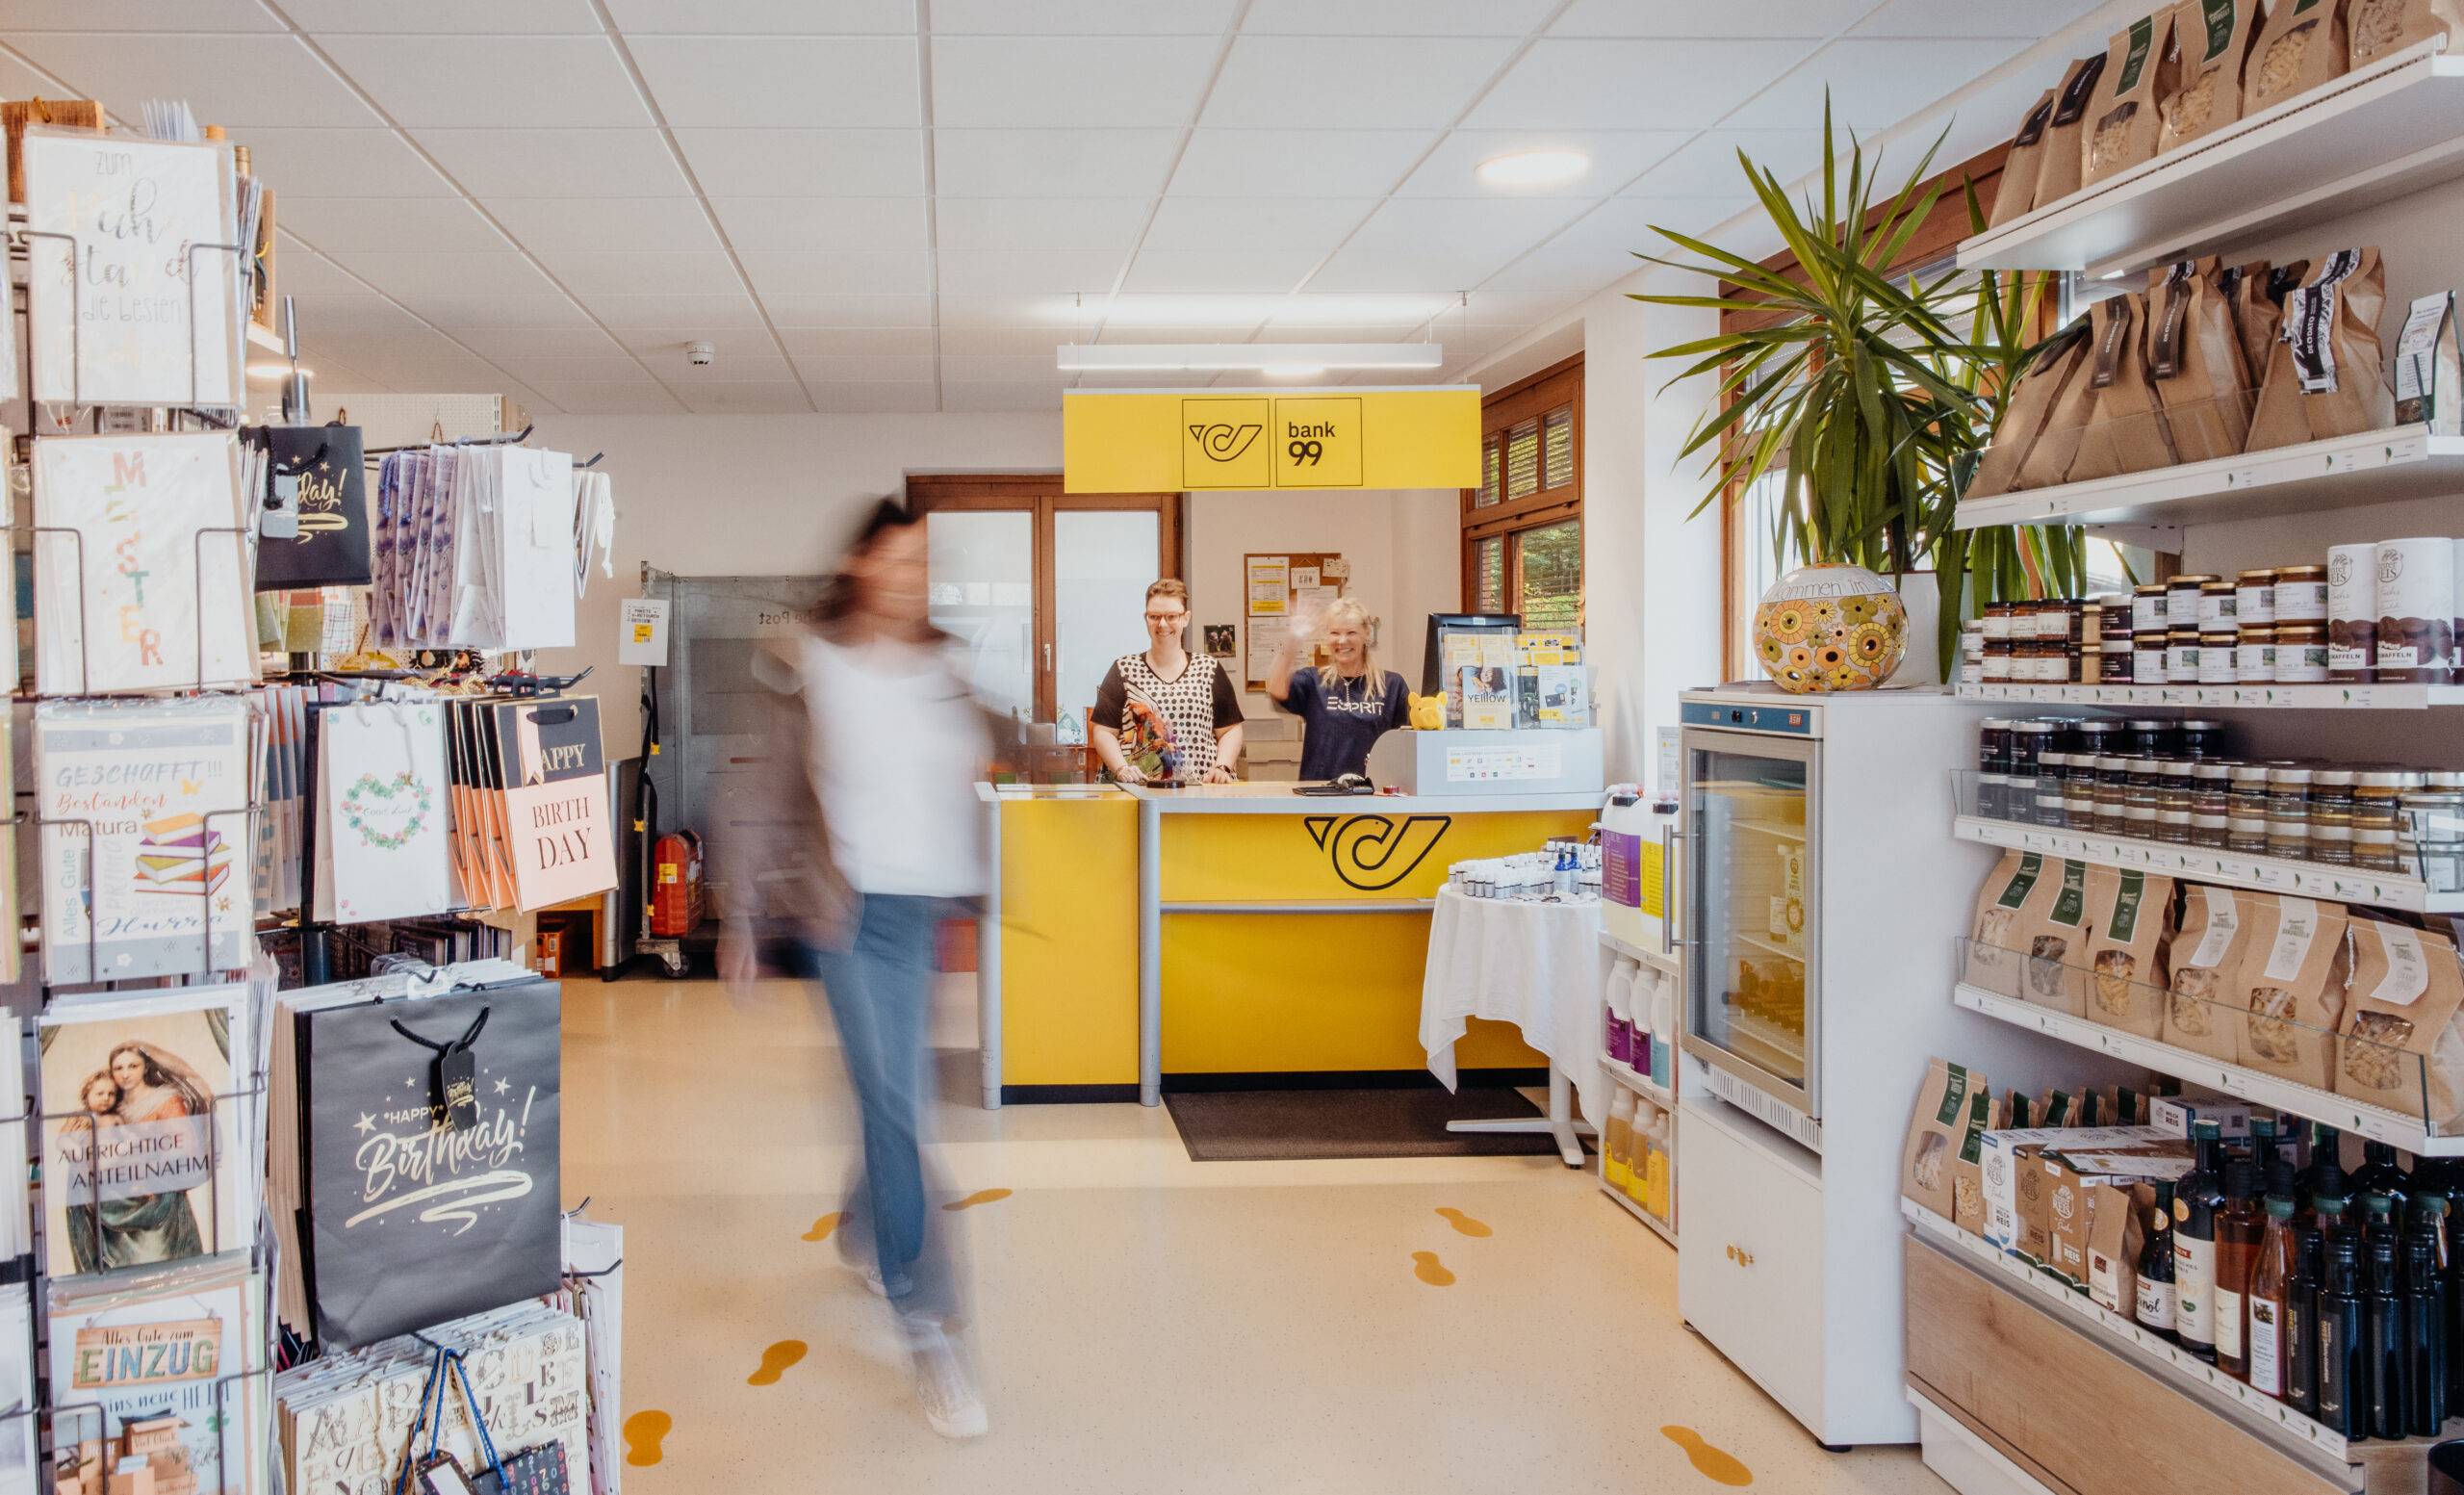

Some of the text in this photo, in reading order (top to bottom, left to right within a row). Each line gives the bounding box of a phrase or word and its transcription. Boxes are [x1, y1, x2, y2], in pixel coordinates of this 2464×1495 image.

[1288, 421, 1336, 438] bank
[1288, 440, 1323, 467] 99
[1847, 579, 1871, 594] im
[1326, 696, 1385, 716] ESPRIT
[541, 742, 586, 771] APPY
[56, 791, 167, 815] Bestanden
[531, 796, 590, 829] BIRTH
[59, 819, 138, 838] Matura
[537, 827, 592, 871] DAY
[61, 848, 78, 939] Alles Gute
[389, 1105, 438, 1125] HAPPY
[58, 1133, 186, 1164] AUFRICHTIGE
[355, 1085, 537, 1203] Birthday!
[72, 1151, 222, 1190] ANTEILNAHME
[1996, 1215, 2011, 1228] REIS
[2064, 1247, 2081, 1263] REIS
[101, 1327, 132, 1347] Alles
[169, 1328, 194, 1340] zum
[79, 1339, 214, 1384] EINZUG
[108, 1397, 133, 1414] ins
[138, 1388, 179, 1408] neue
